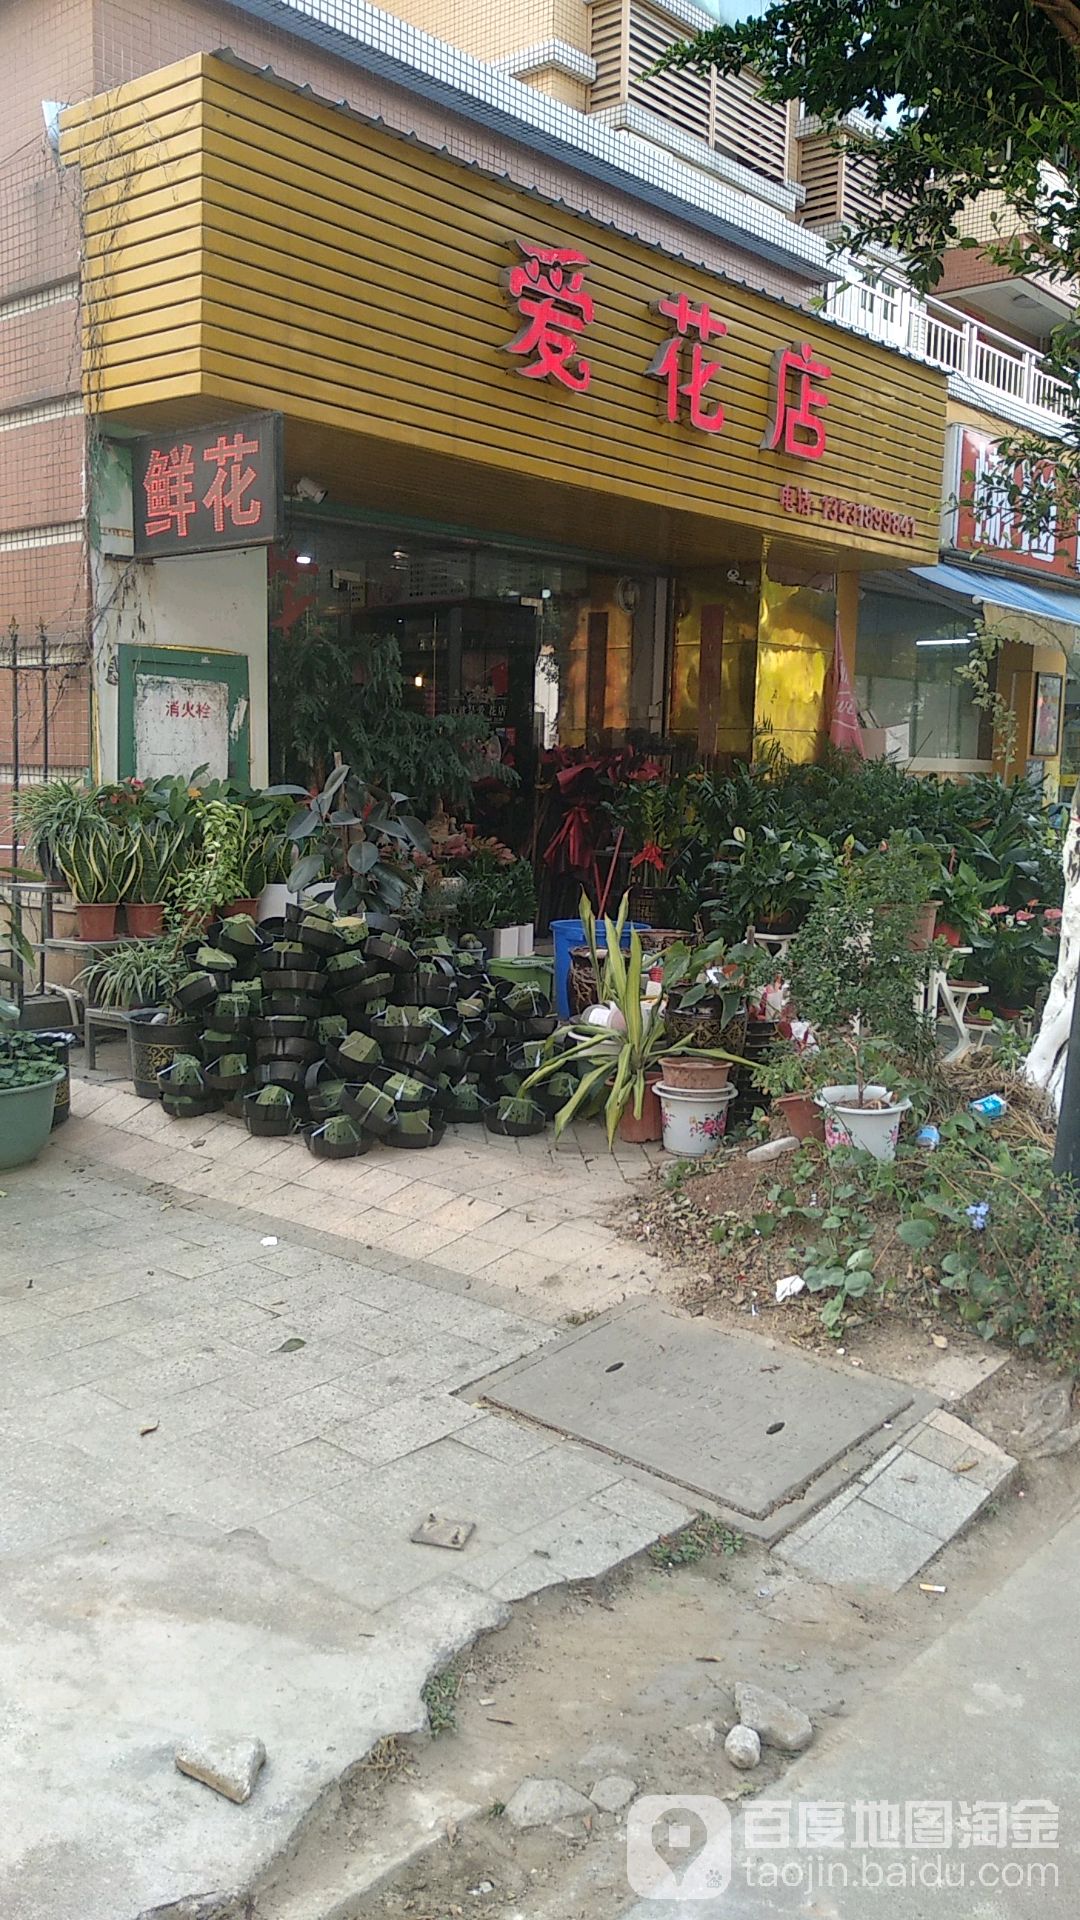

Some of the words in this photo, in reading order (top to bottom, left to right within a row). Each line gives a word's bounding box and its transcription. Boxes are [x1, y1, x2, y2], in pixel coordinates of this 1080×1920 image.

[503, 239, 832, 460] 爱花店
[143, 433, 262, 537] 鲜花
[821, 495, 917, 539] 13531899841
[165, 700, 211, 719] 消火栓
